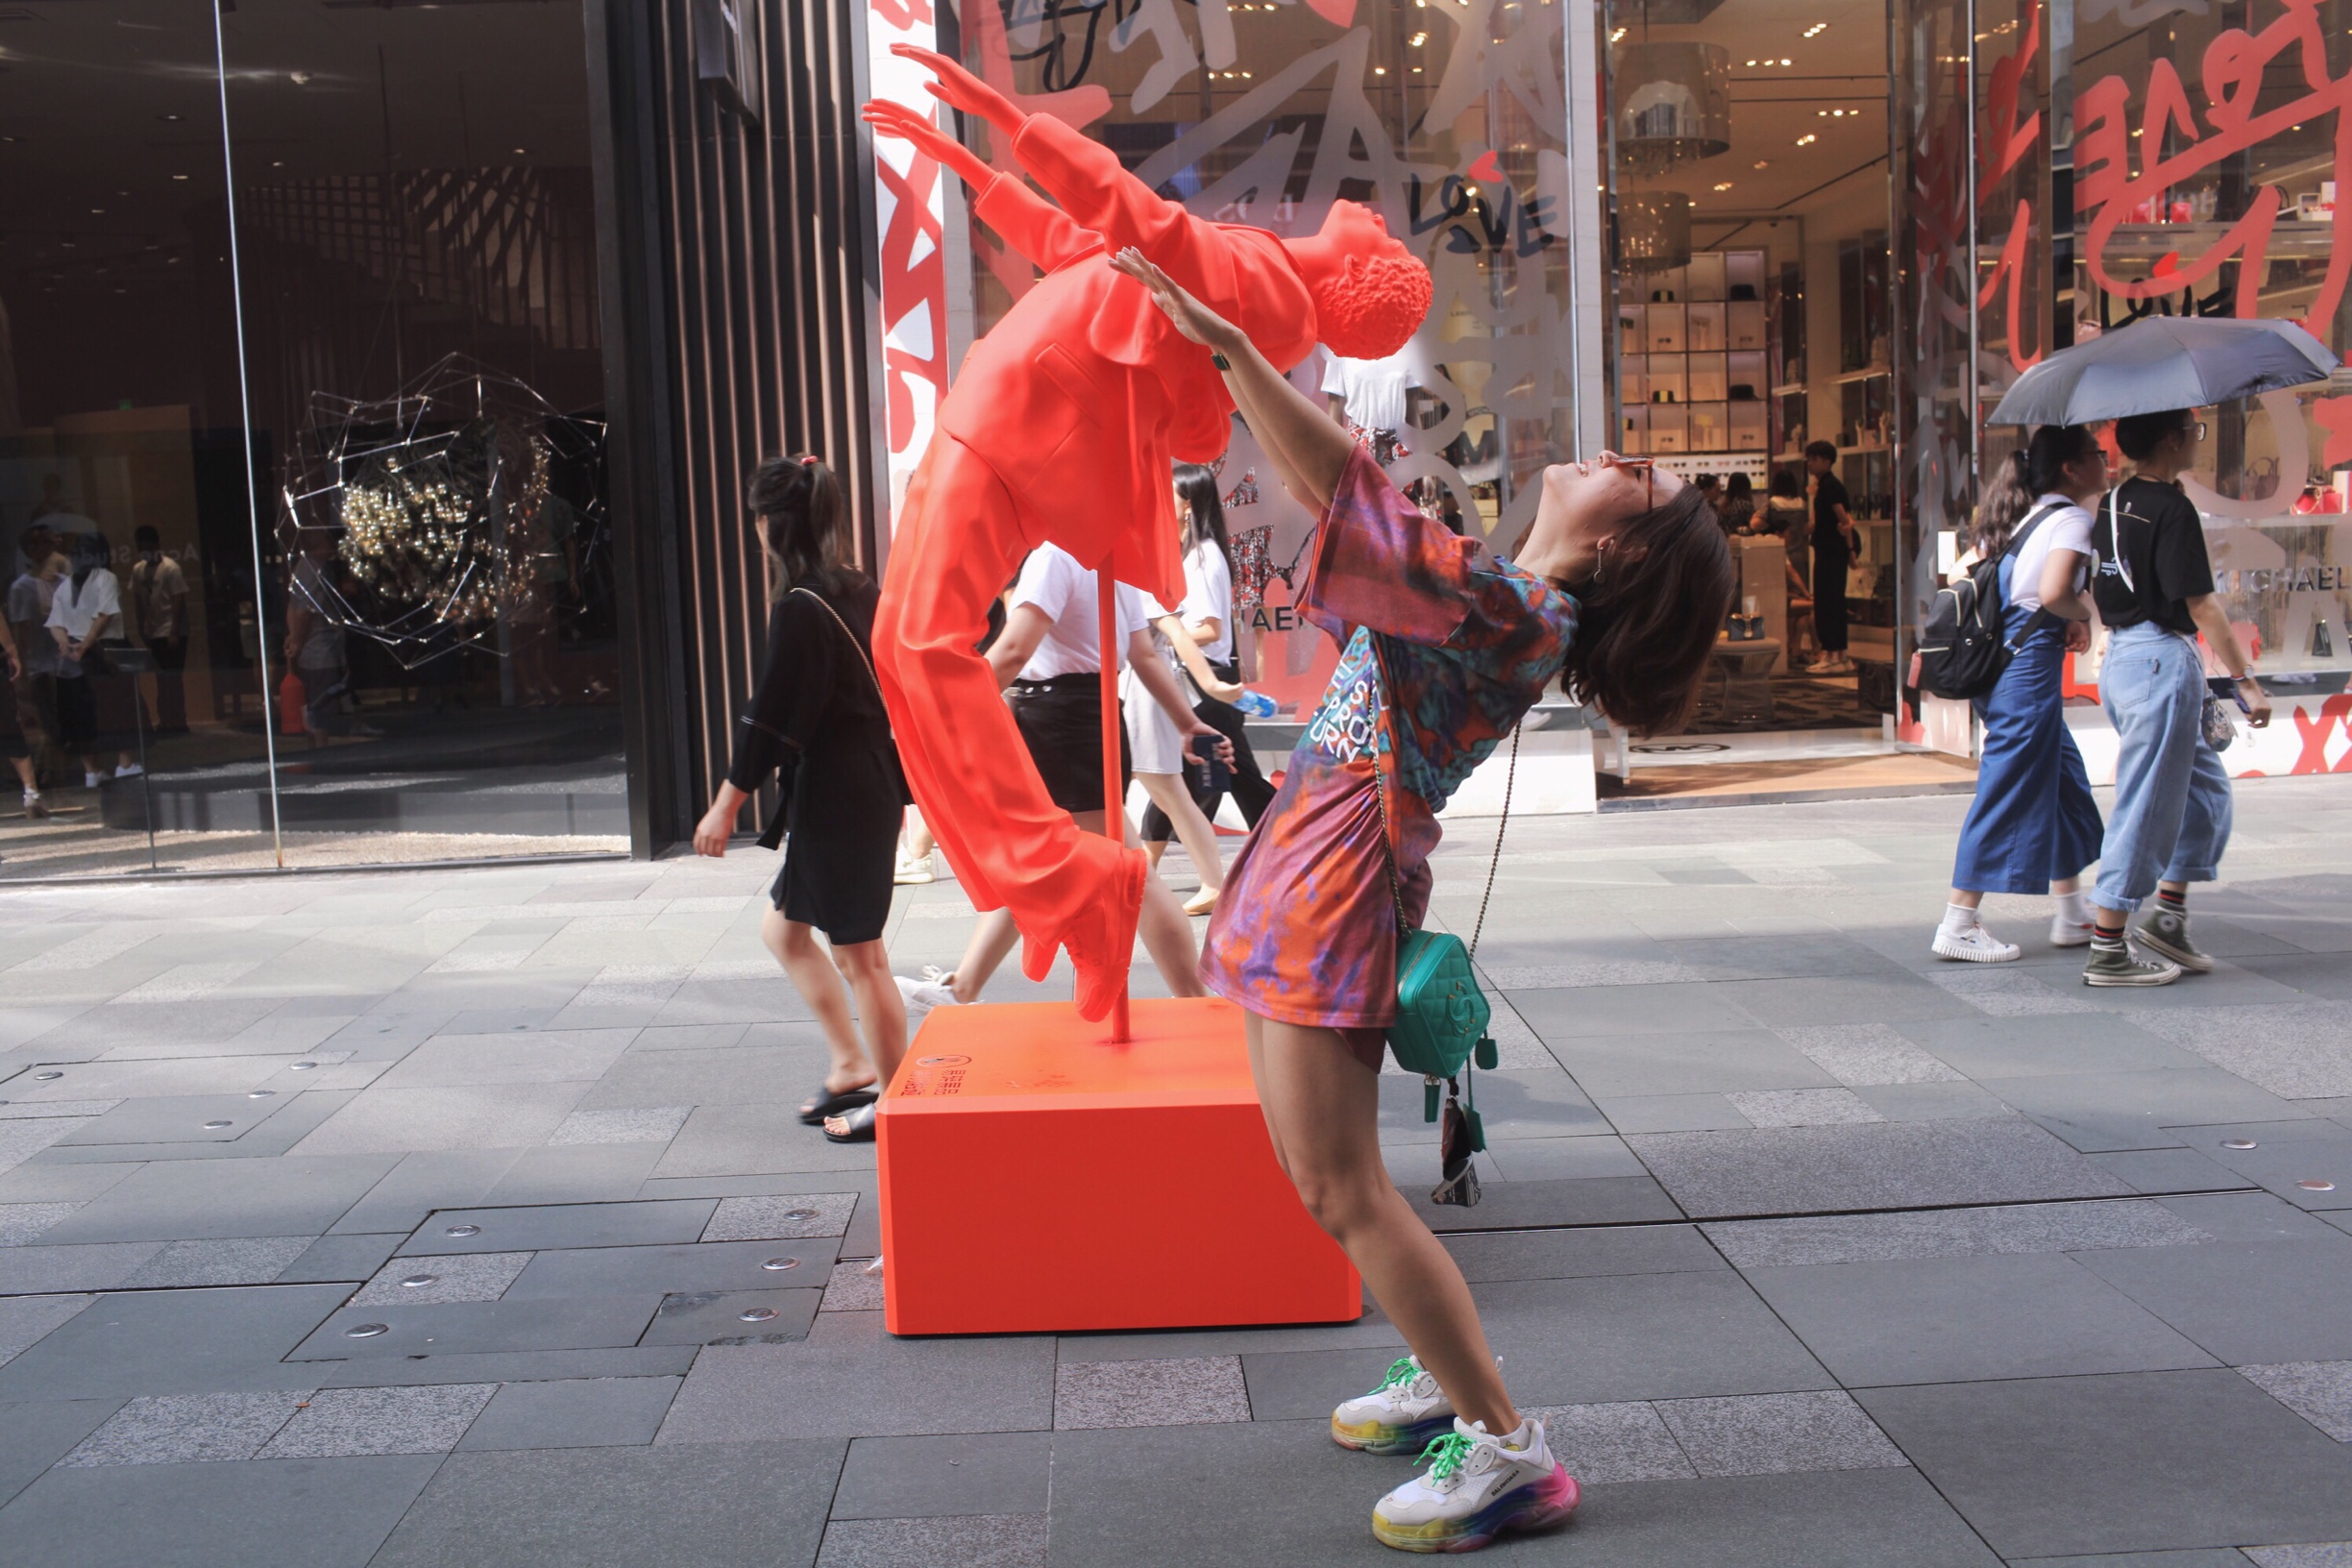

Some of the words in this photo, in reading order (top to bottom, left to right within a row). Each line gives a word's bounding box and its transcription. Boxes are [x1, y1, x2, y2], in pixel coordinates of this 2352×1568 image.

[1409, 171, 1558, 259] LOVE
[1310, 711, 1360, 764] URN
[1491, 1470, 1520, 1496] BALENCIAGA
